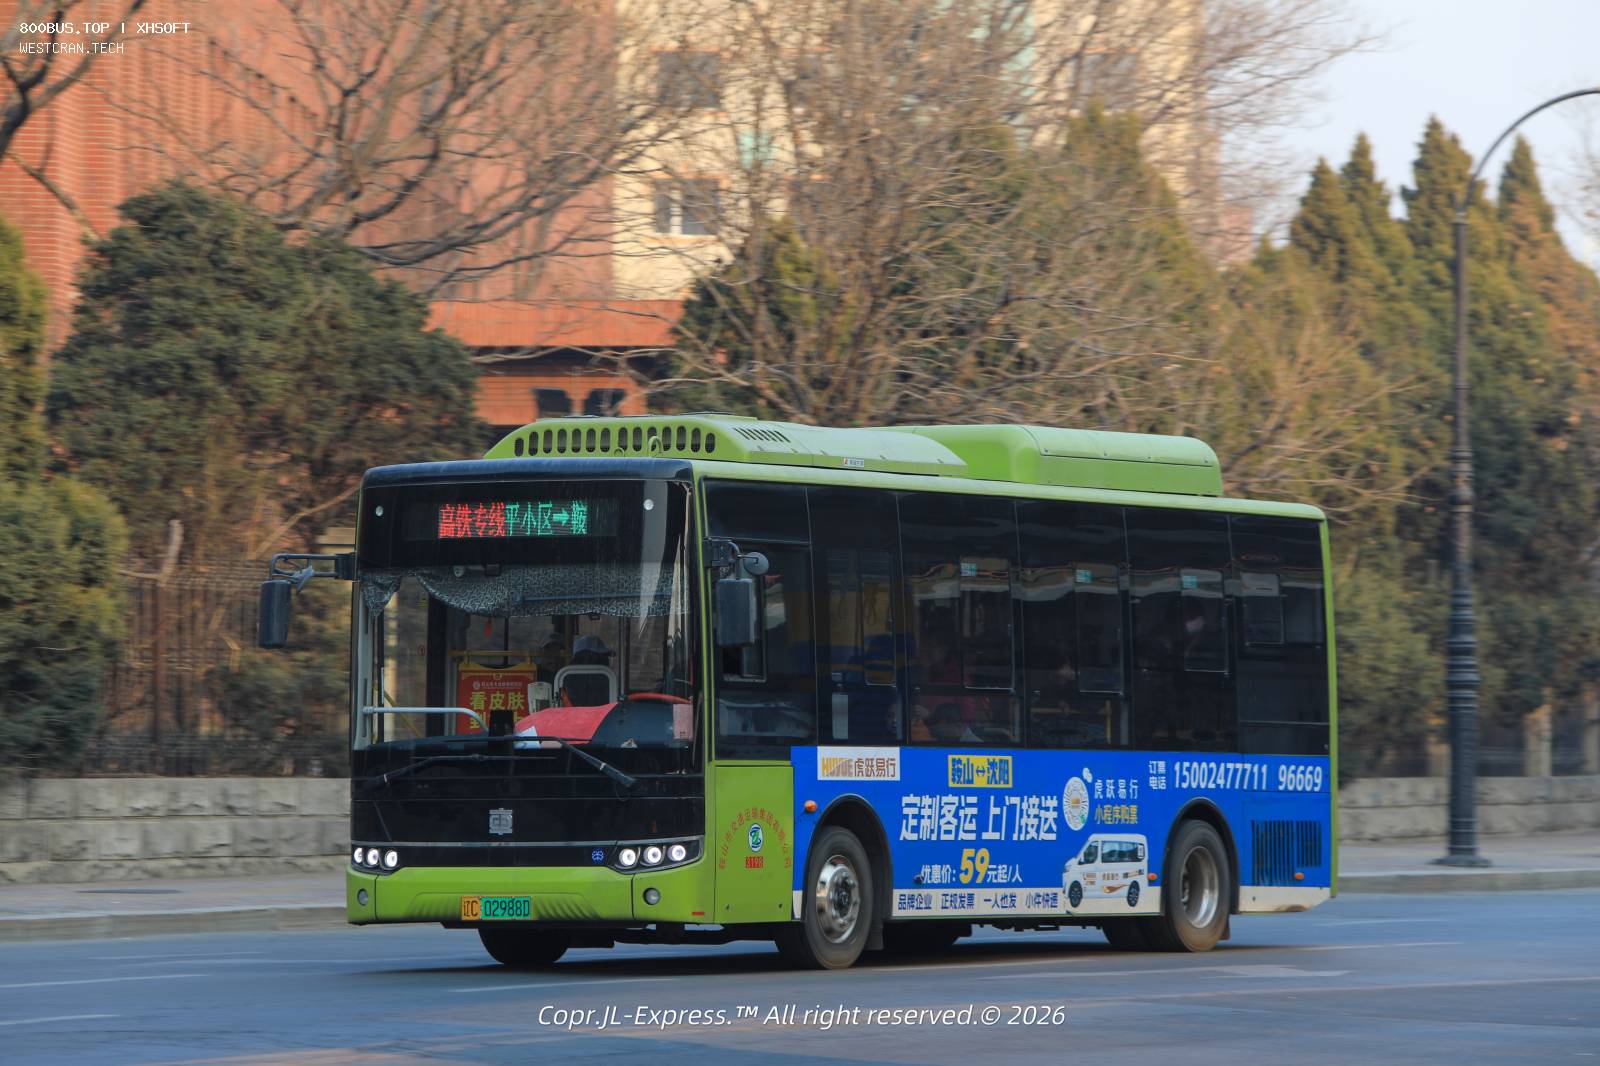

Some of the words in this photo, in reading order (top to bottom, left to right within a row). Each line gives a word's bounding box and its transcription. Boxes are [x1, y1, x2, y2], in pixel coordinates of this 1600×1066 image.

[854, 757, 897, 778] 虎跃易行
[1174, 761, 1268, 790] 15002477711
[1277, 764, 1323, 792] 96669
[900, 793, 978, 841] 定制客运
[981, 794, 1059, 841] 上门接送
[898, 893, 932, 911] 品牌企业
[940, 893, 975, 910] 正规发票
